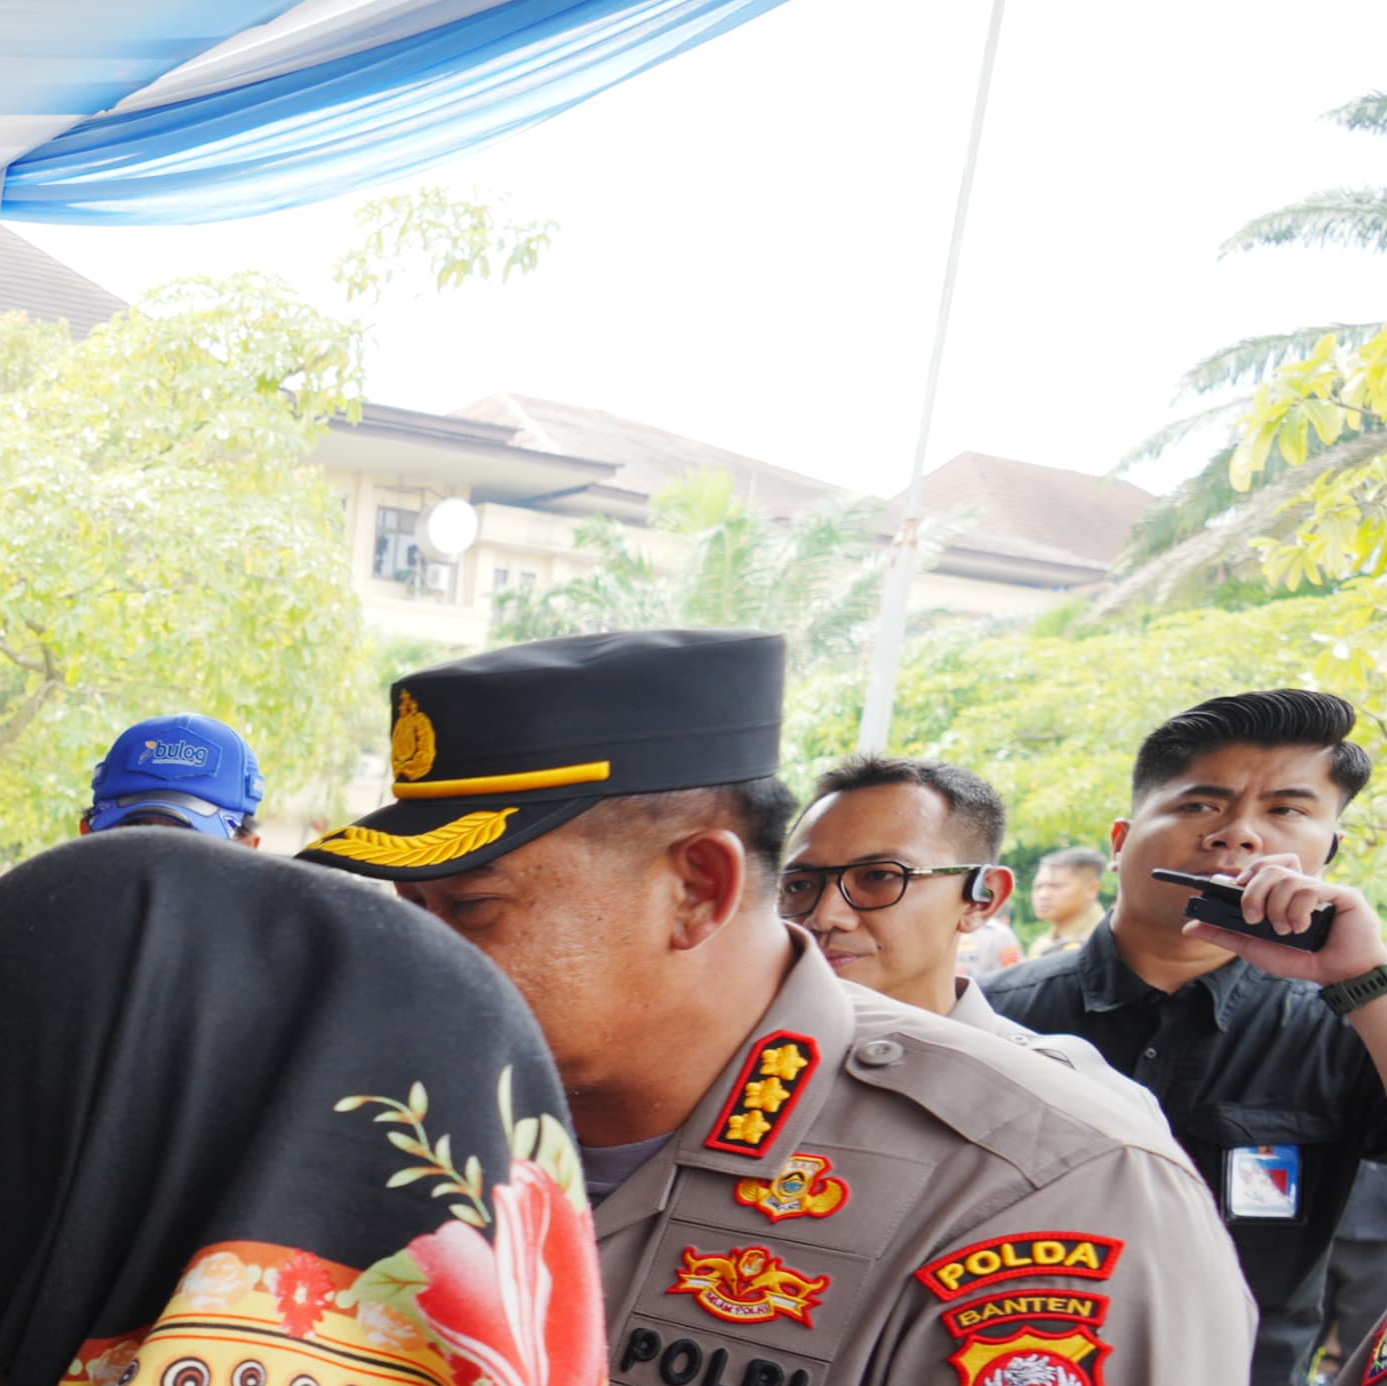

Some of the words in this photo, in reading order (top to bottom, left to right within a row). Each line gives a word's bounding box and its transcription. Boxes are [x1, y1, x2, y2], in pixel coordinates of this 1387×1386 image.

[155, 739, 209, 768] bulog
[937, 1240, 1100, 1291] POLDA
[958, 1296, 1094, 1327] BANTEN
